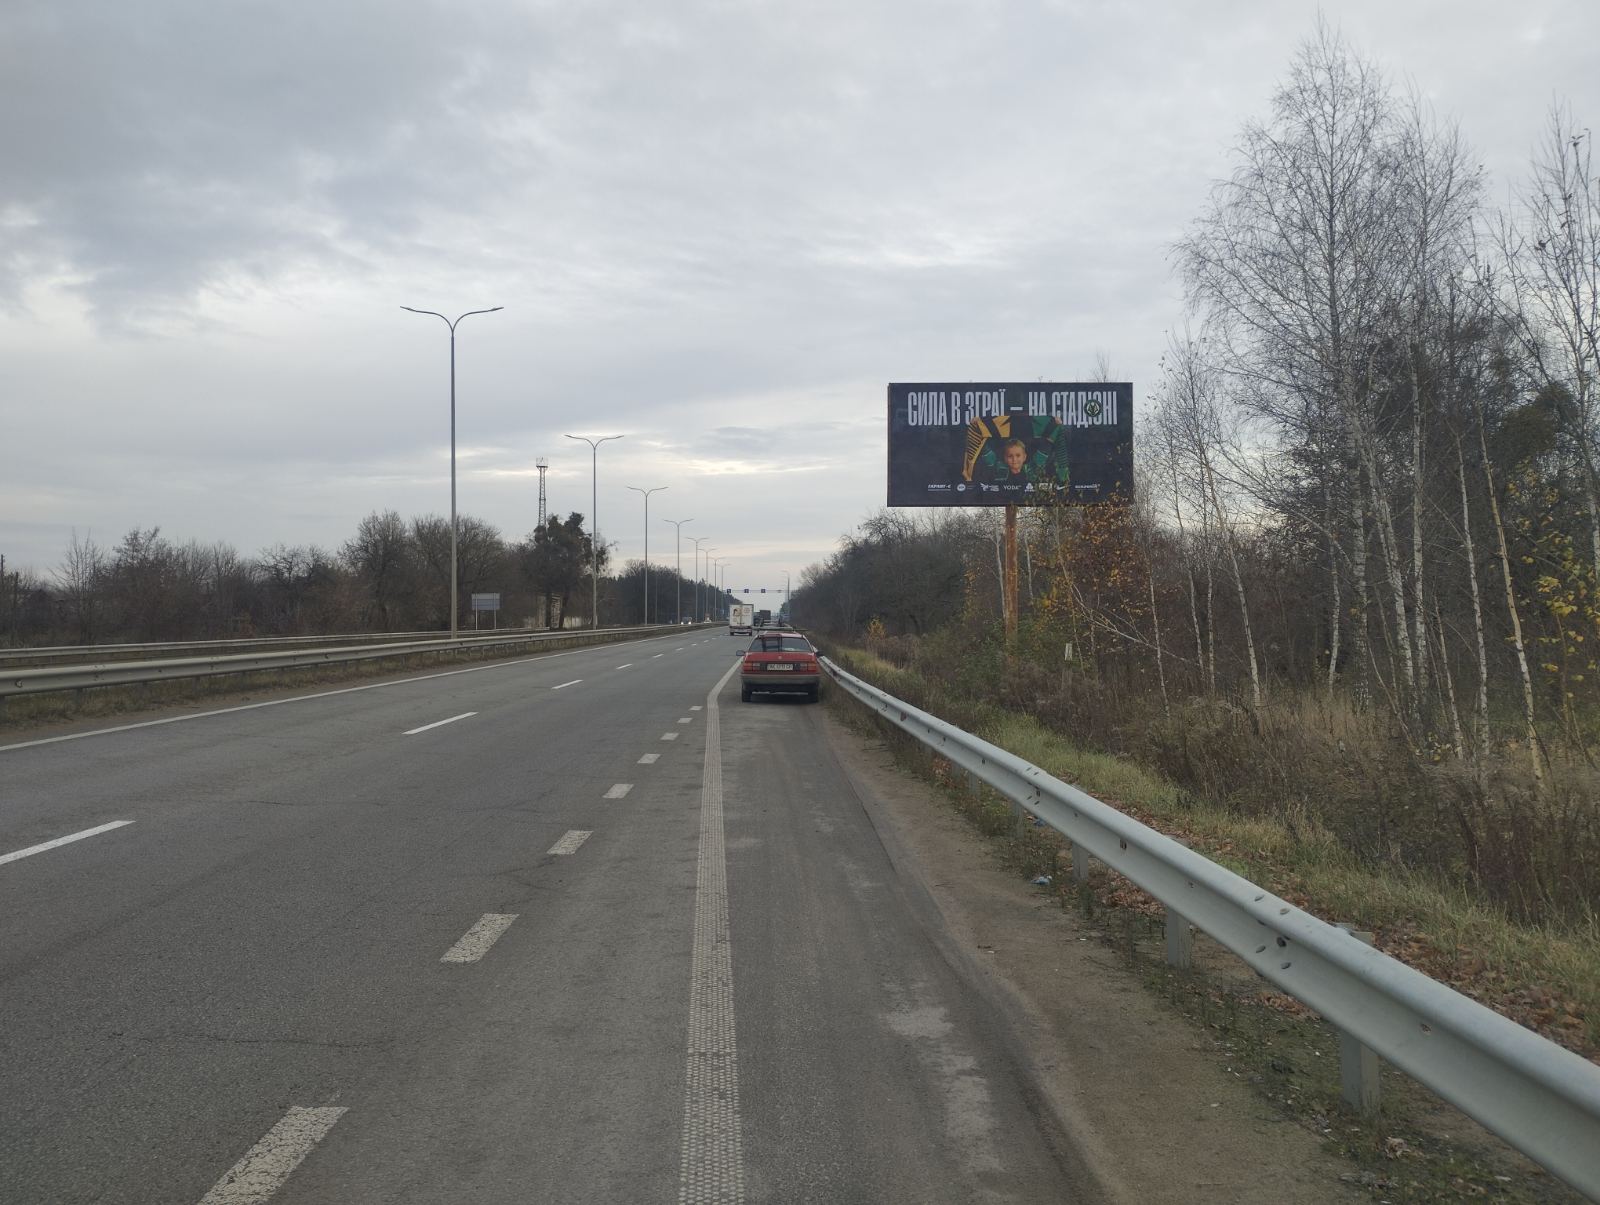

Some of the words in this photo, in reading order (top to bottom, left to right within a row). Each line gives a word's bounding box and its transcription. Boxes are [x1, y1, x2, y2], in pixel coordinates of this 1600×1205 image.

[907, 391, 948, 426] СИЛА
[951, 391, 961, 425] В
[965, 388, 1006, 426] ЗГРАЇ
[1028, 391, 1047, 417] НА
